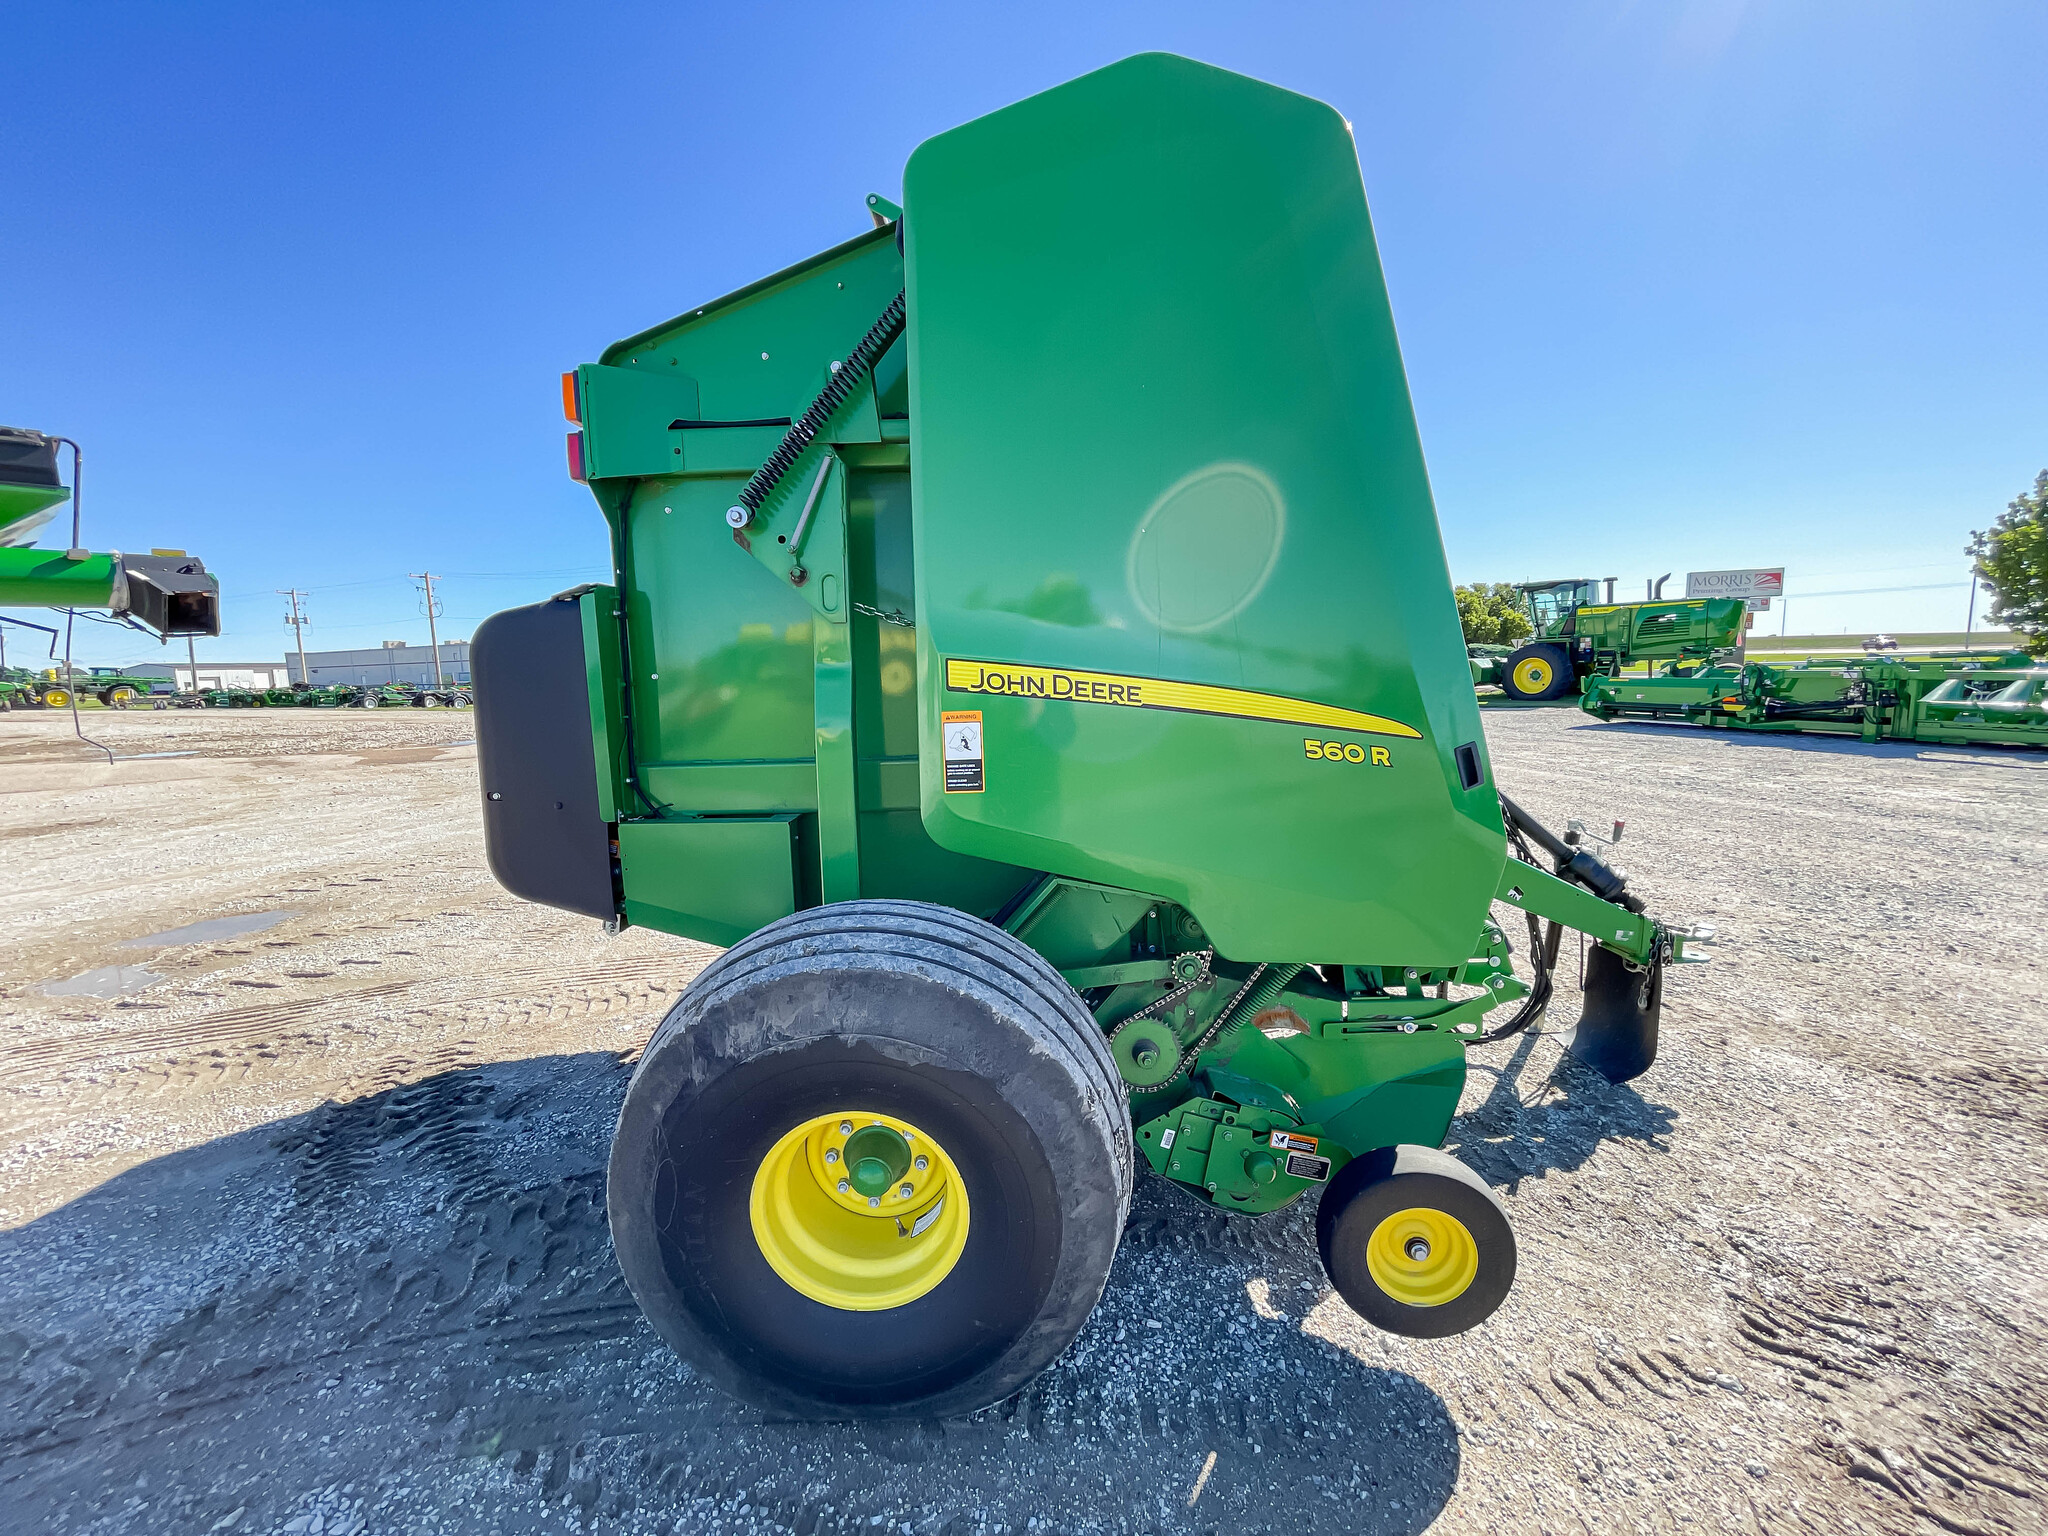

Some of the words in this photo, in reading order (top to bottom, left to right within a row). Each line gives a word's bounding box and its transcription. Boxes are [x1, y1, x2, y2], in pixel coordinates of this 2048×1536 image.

[1694, 574, 1752, 587] MORRIS
[970, 668, 1045, 694] JOHN
[1052, 674, 1142, 703] DEERE
[1303, 738, 1366, 764] 560
[1370, 745, 1394, 768] R
